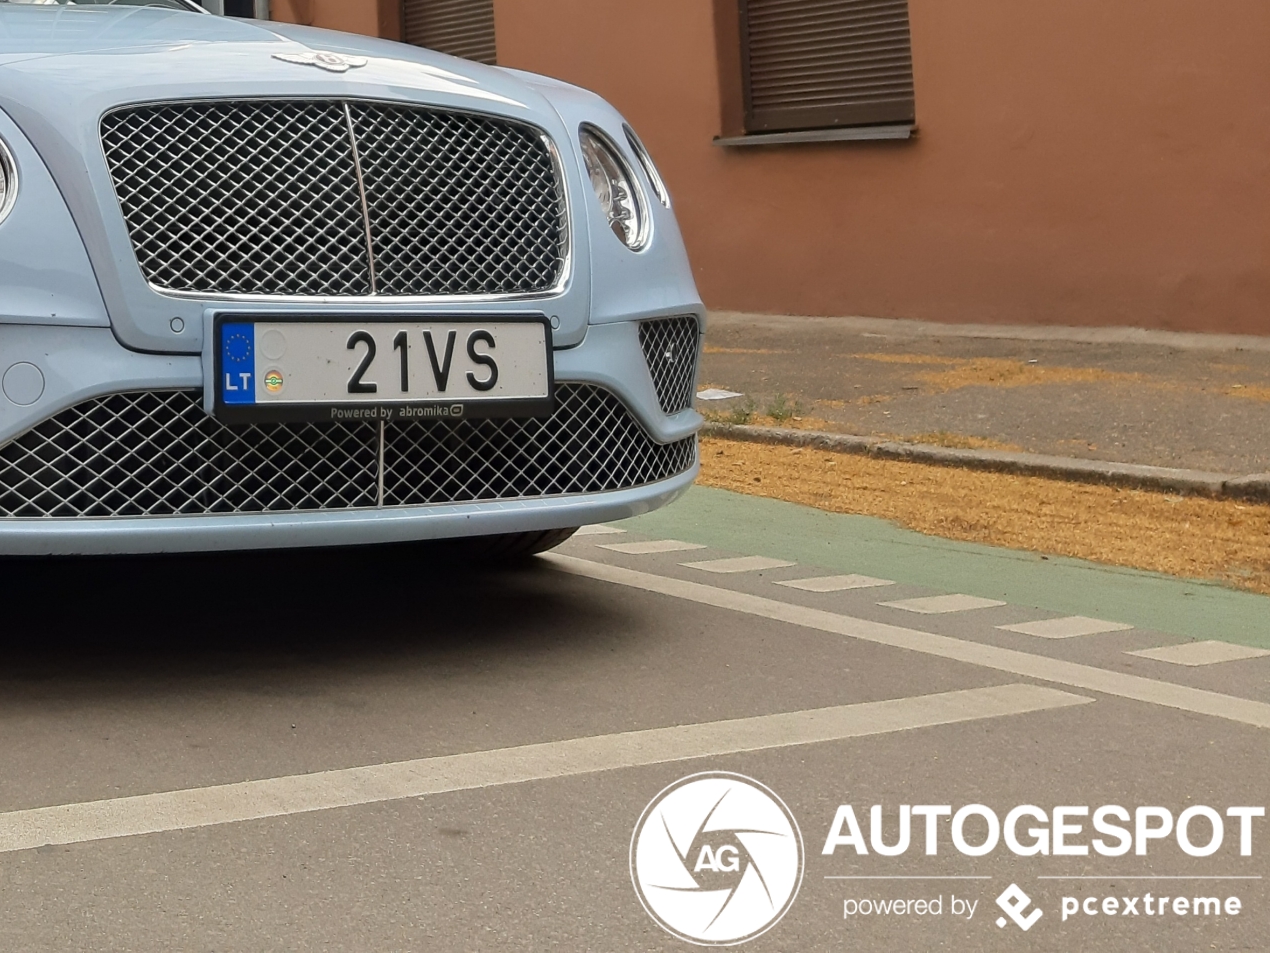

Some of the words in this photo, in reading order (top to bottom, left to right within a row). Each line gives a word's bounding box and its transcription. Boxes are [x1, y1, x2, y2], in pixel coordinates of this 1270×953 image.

[225, 372, 252, 391] LT
[346, 329, 499, 394] 21VS
[330, 406, 377, 419] Powered
[380, 407, 393, 420] by
[399, 405, 449, 417] abromika
